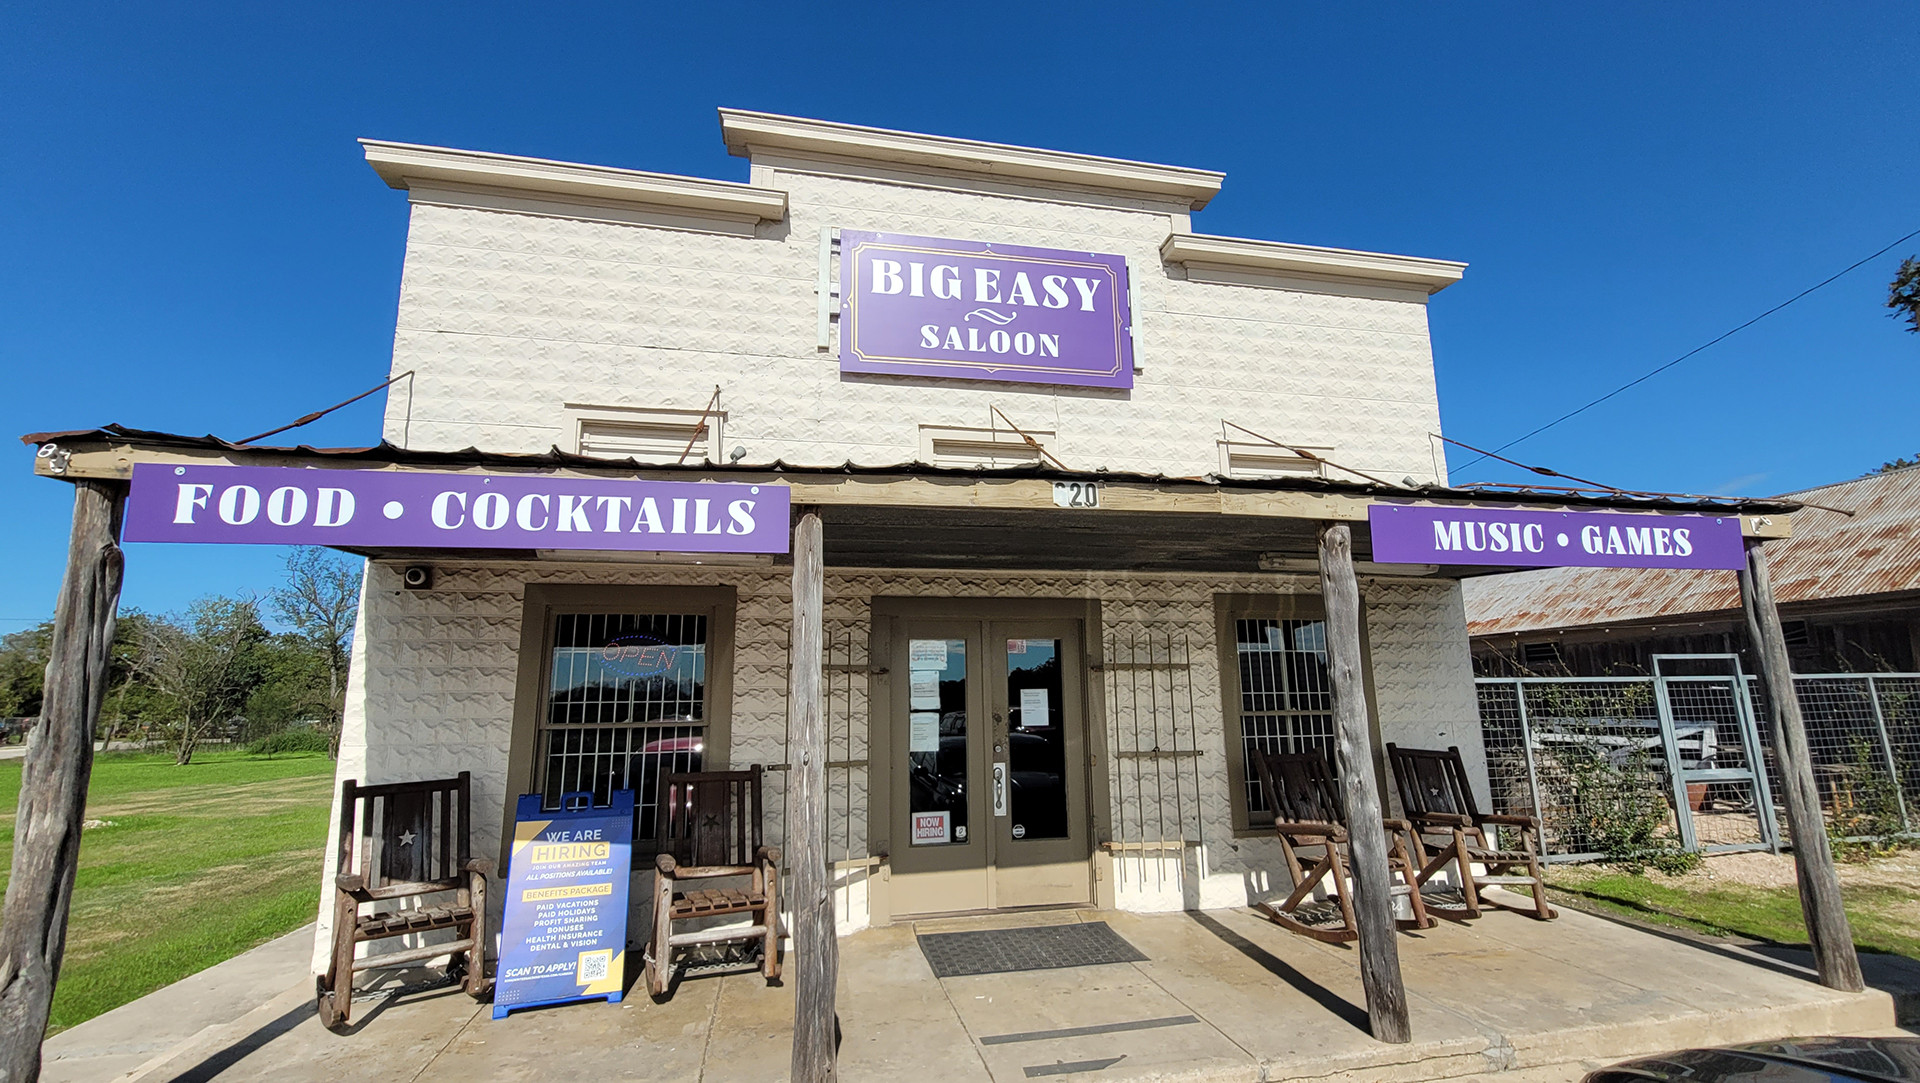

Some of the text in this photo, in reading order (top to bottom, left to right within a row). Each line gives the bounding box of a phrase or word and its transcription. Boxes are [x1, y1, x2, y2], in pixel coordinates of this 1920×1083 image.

[870, 258, 1101, 312] BIG EASY
[920, 324, 1060, 358] SALOON
[1055, 482, 1098, 508] 20
[172, 483, 757, 536] FOOD COCKTAILS
[1432, 520, 1693, 556] MUSIC GAMES
[603, 642, 676, 670] OPEN
[920, 817, 940, 828] NOW
[546, 829, 602, 842] WE ARE
[916, 826, 944, 838] HIRING
[536, 843, 606, 861] HIRING
[540, 871, 576, 879] POSITIONS
[575, 868, 613, 877] AVAILABLE!
[526, 884, 609, 899] BENEFITS PACKAGE
[536, 899, 599, 911] PAID VACATIONS
[538, 907, 596, 919] PAID HOLIDAYS
[533, 915, 598, 927] PROFIT SHARING
[547, 924, 584, 934] BONUSES
[525, 930, 603, 944] HEALTH INSURANCE
[530, 938, 598, 952] DENTAL & VISION
[505, 966, 531, 978] SCAN
[532, 965, 546, 975] TO
[546, 961, 577, 973] APPLY!
